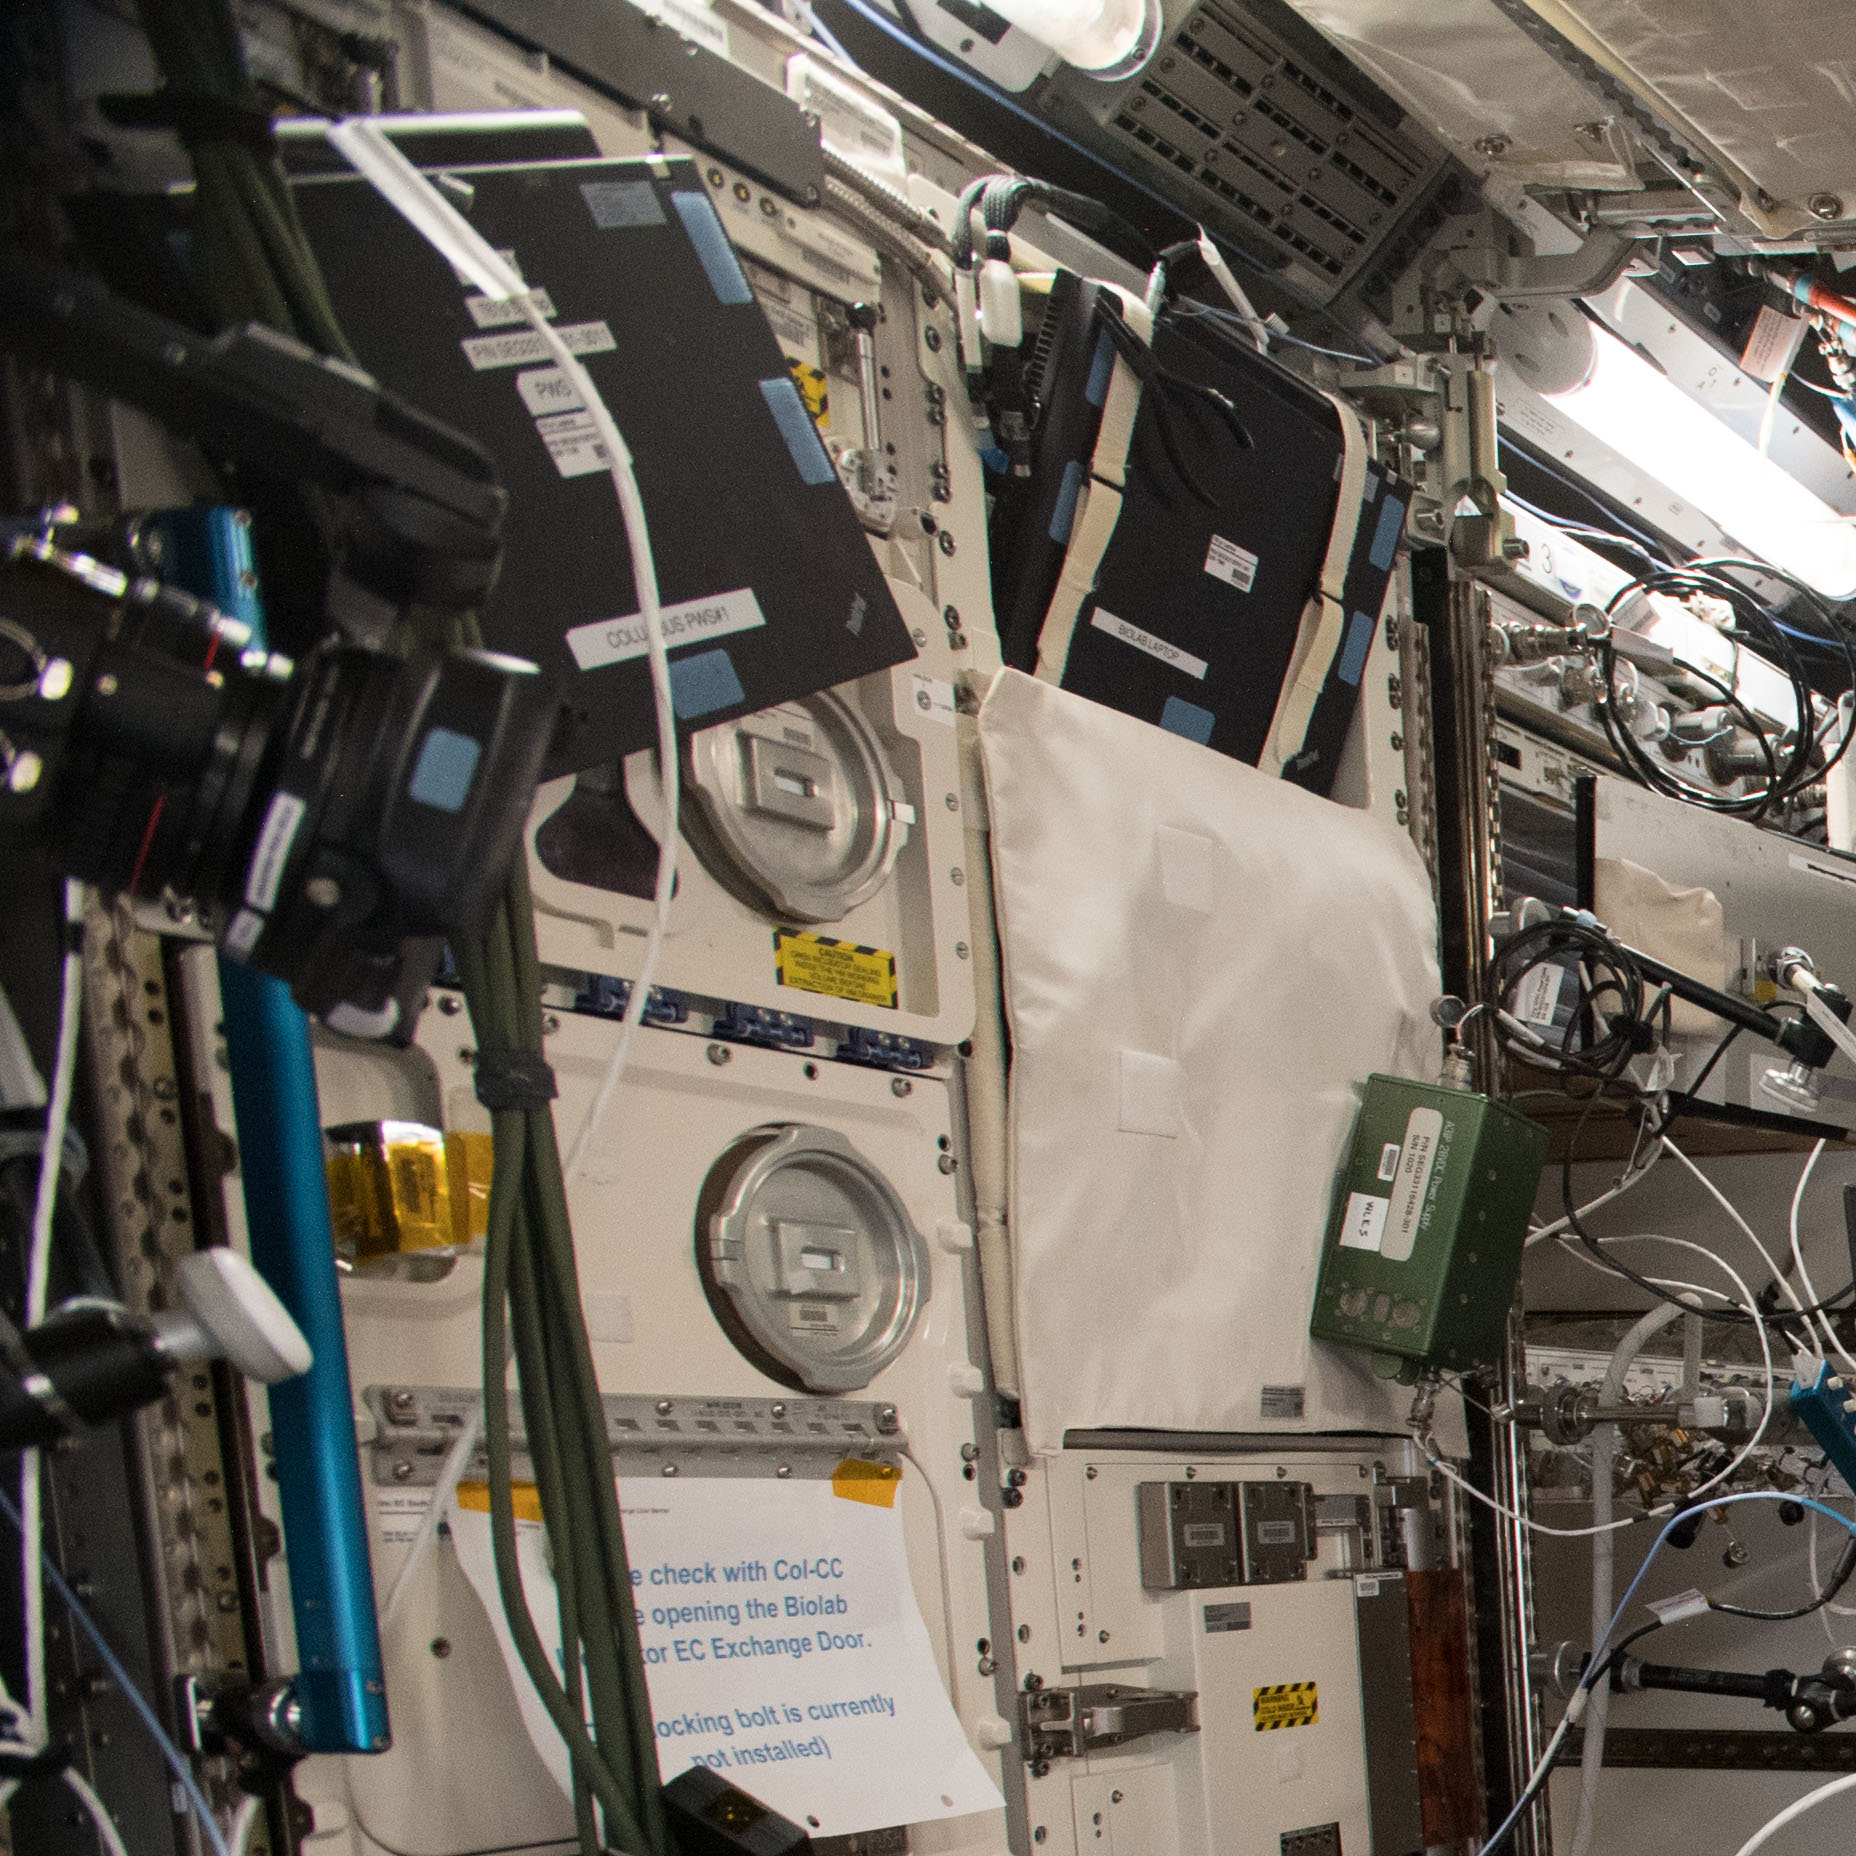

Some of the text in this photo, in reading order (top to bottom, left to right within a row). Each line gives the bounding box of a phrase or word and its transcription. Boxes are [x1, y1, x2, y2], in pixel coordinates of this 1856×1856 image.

[607, 617, 684, 649] COLUUS
[1118, 625, 1179, 660] BIOLAB LAPTOP
[1404, 1134, 1420, 1174] S/N 1020
[1418, 1136, 1430, 1151] P/N
[1430, 1177, 1443, 1200] Power
[1419, 1203, 1435, 1231] Supply
[650, 1562, 716, 1587] check
[723, 1560, 768, 1582] with
[774, 1557, 844, 1580] Col-CC
[652, 1601, 741, 1628] opening
[745, 1598, 779, 1620] the
[784, 1594, 848, 1618] Biolab
[675, 1629, 872, 1662] EC Exchange Door.
[656, 1692, 895, 1738] ocking bolt is currently
[691, 1736, 832, 1770] not installed)
